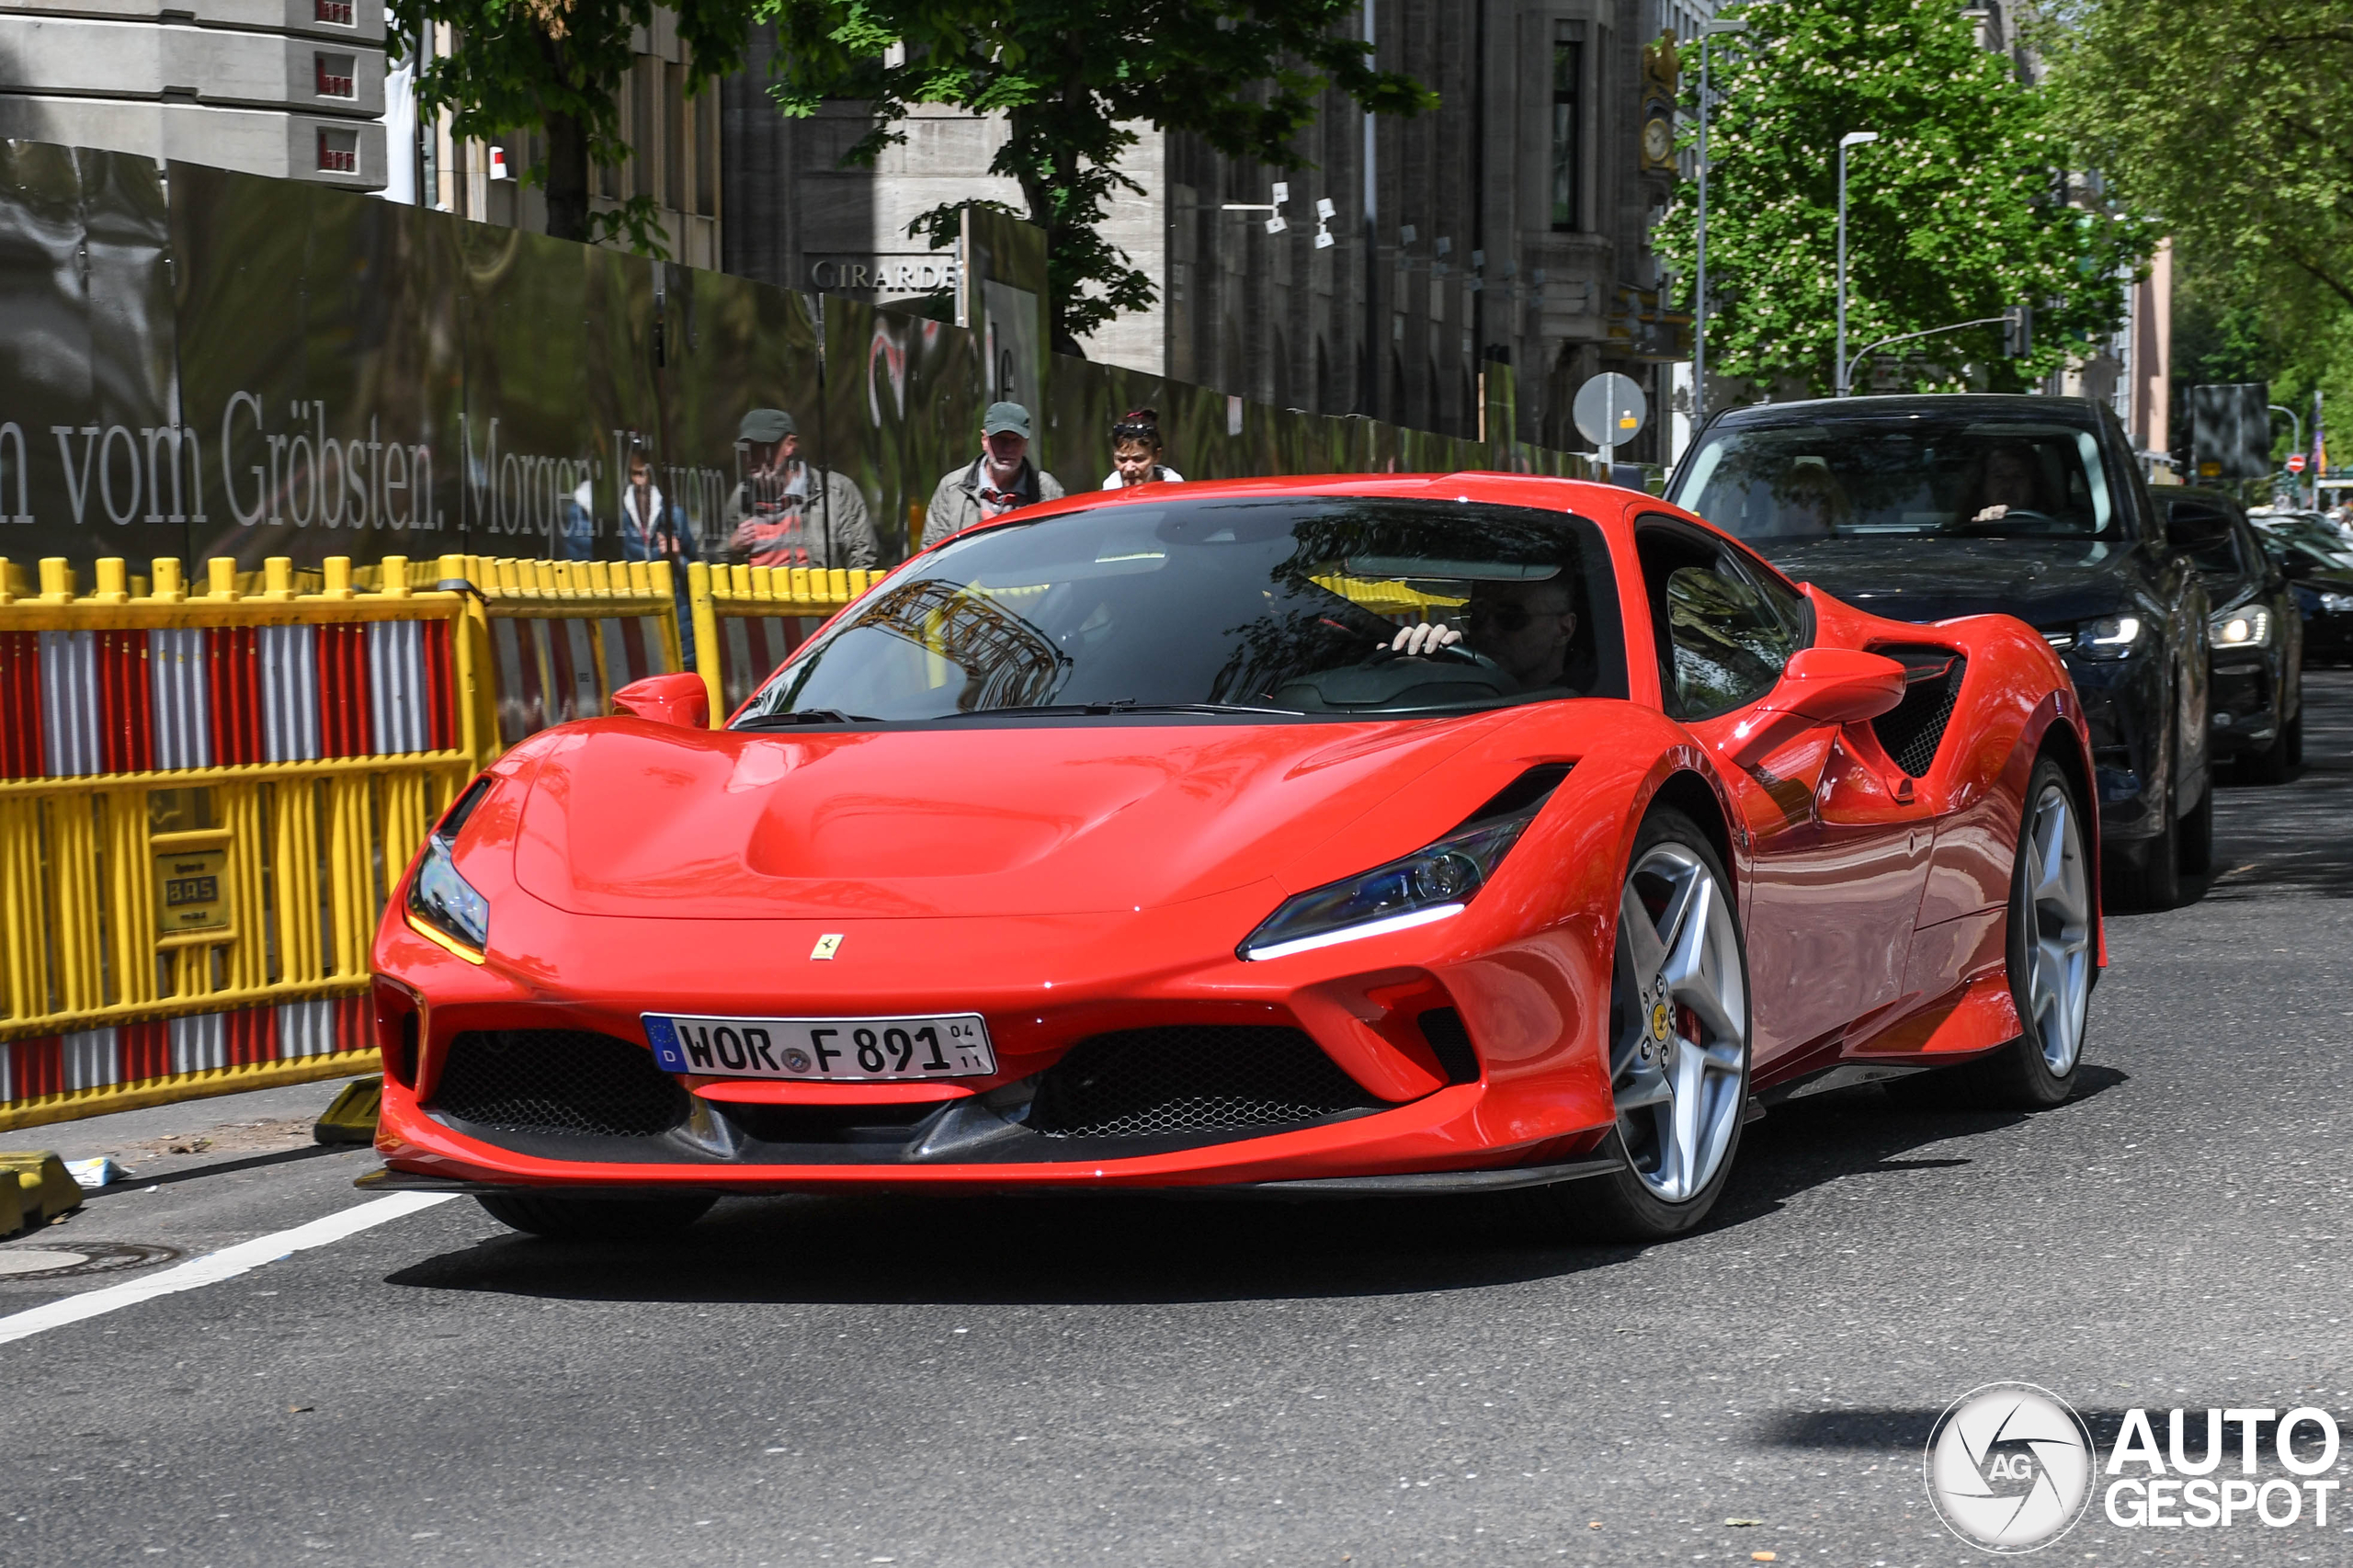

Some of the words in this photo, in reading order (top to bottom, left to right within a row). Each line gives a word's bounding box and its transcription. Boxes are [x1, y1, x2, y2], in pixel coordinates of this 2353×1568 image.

[50, 424, 208, 526] vom
[222, 390, 445, 531] Gröbsten.
[458, 412, 605, 559] Morgen:
[950, 1024, 974, 1039] 04
[663, 1050, 676, 1062] D
[678, 1025, 780, 1072] WOR
[810, 1028, 842, 1073] F
[852, 1026, 951, 1073] 891
[961, 1054, 982, 1069] 11
